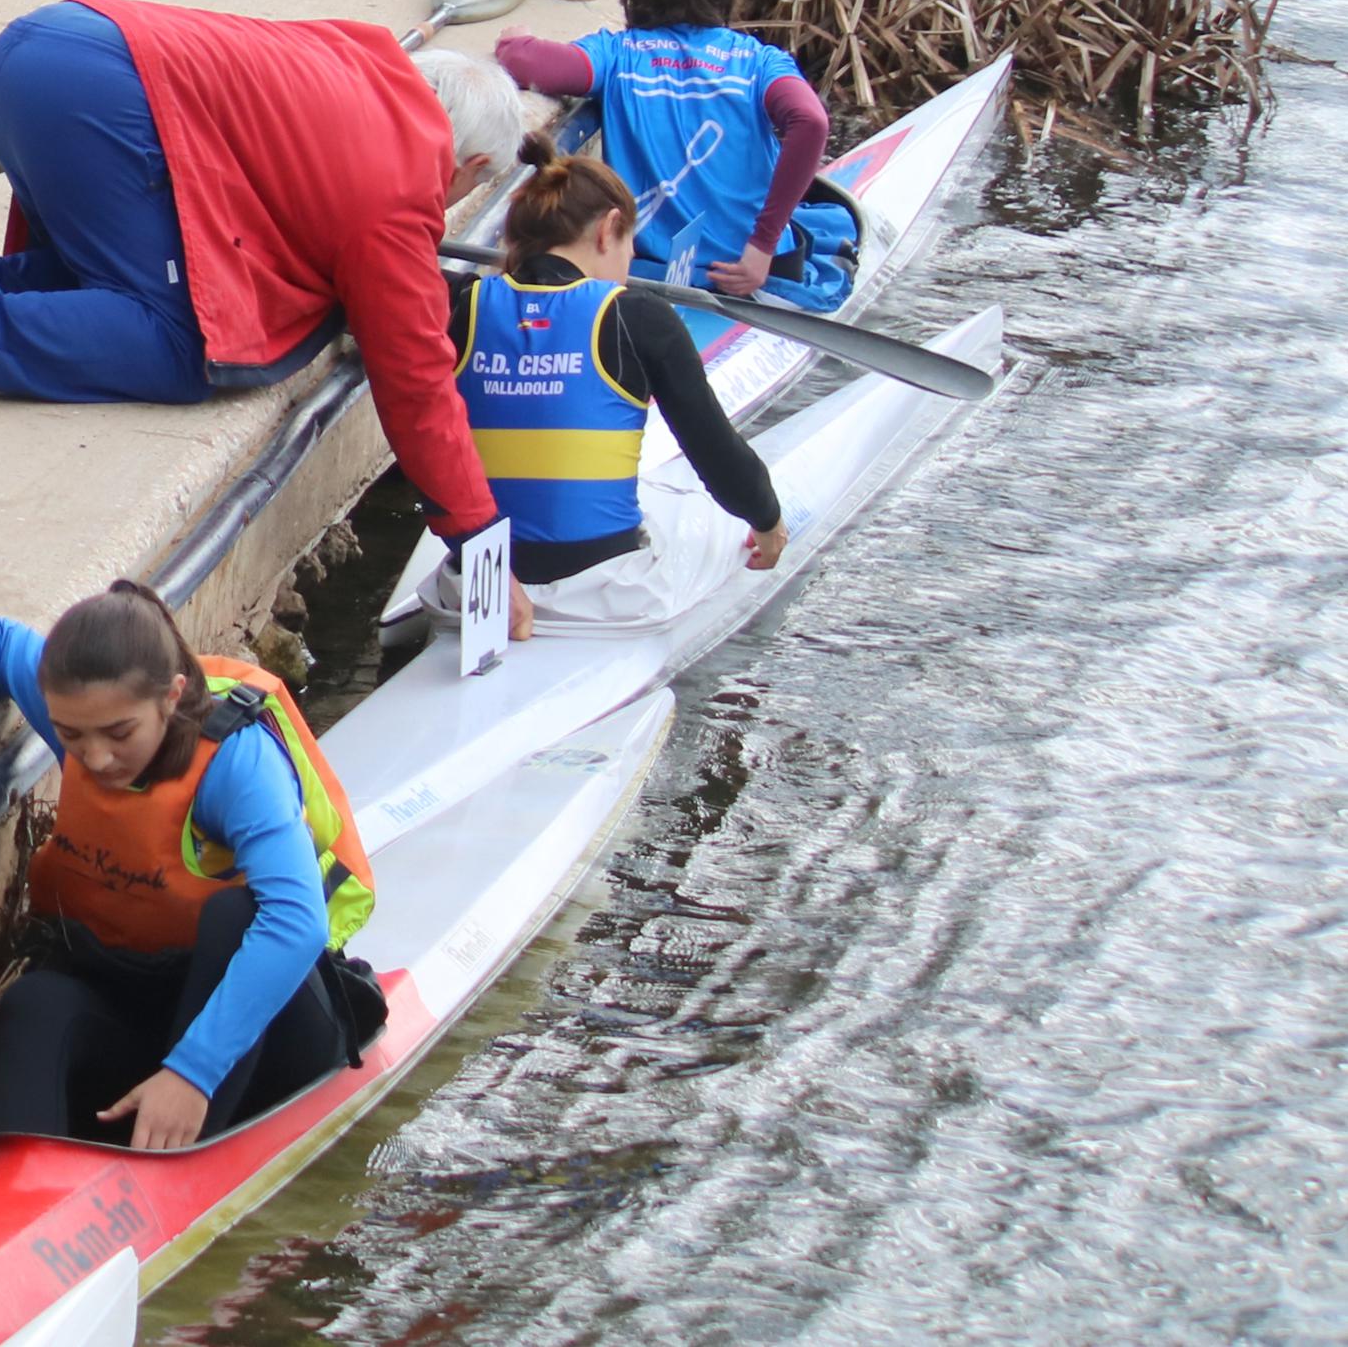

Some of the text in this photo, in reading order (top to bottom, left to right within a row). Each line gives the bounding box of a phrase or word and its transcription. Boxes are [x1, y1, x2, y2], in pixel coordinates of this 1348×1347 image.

[472, 351, 584, 375] C.D. CISNE
[483, 380, 565, 395] VALLADOLID
[468, 543, 503, 624] 401
